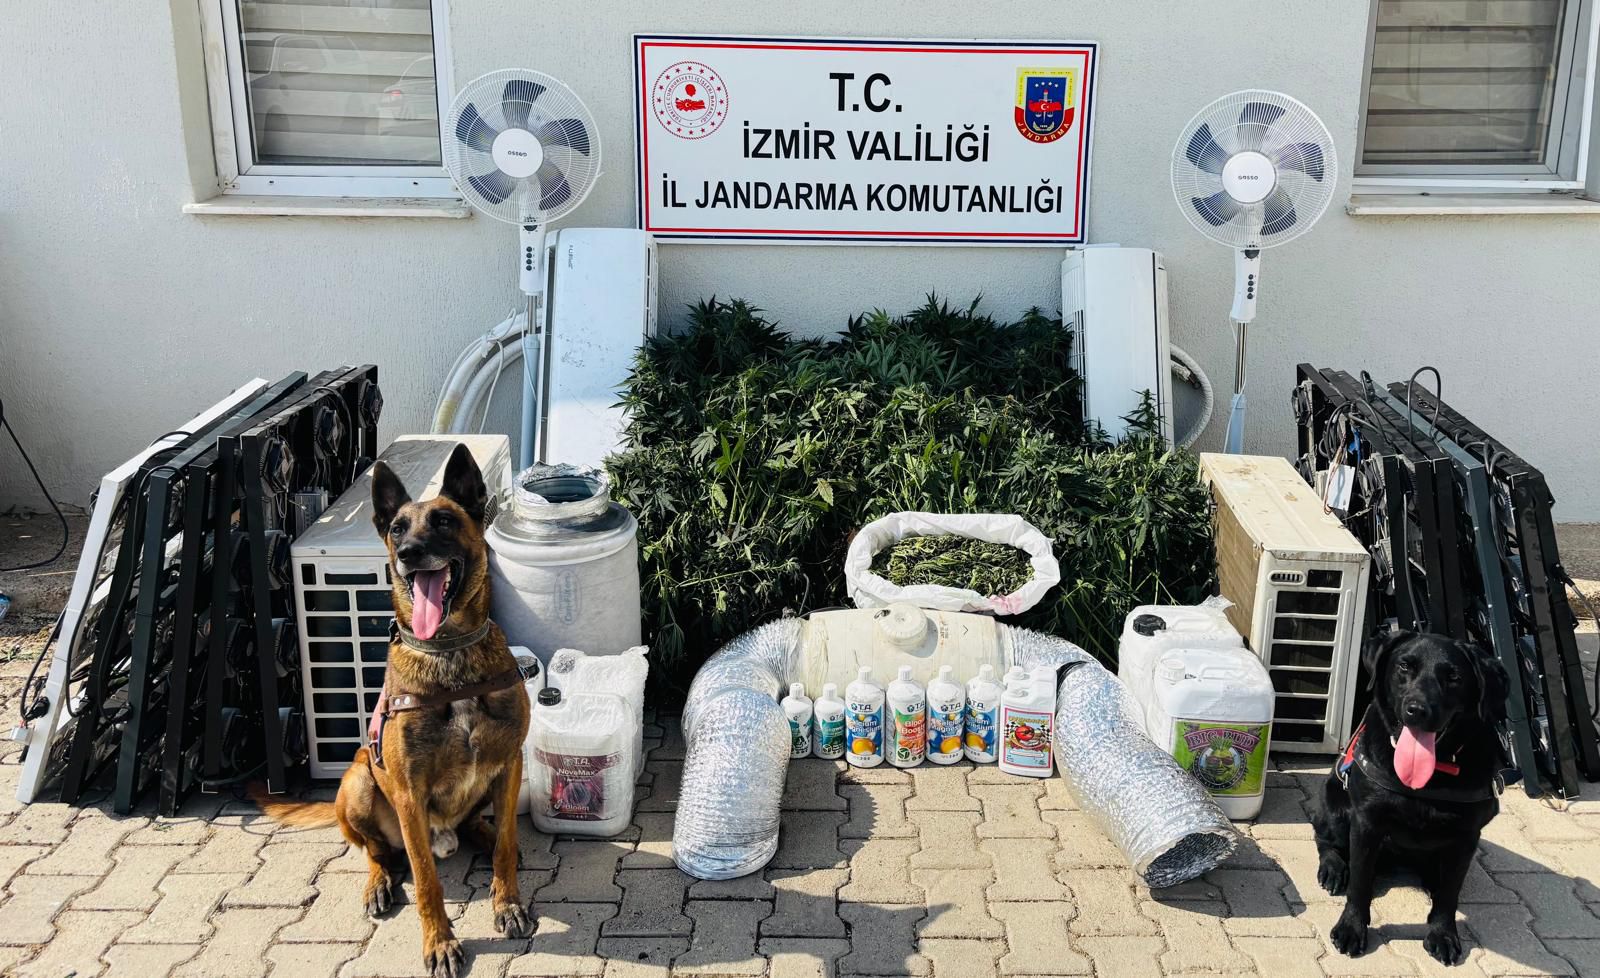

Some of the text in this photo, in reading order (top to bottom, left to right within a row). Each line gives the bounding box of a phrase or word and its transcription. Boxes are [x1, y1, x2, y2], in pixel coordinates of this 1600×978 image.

[829, 72, 902, 112] T.C.
[743, 120, 989, 162] İZMİR VALİLİĞİ
[1017, 122, 1070, 142] JANDARMA
[663, 173, 1062, 213] İL JANDARMA KOMUTANLIĞI
